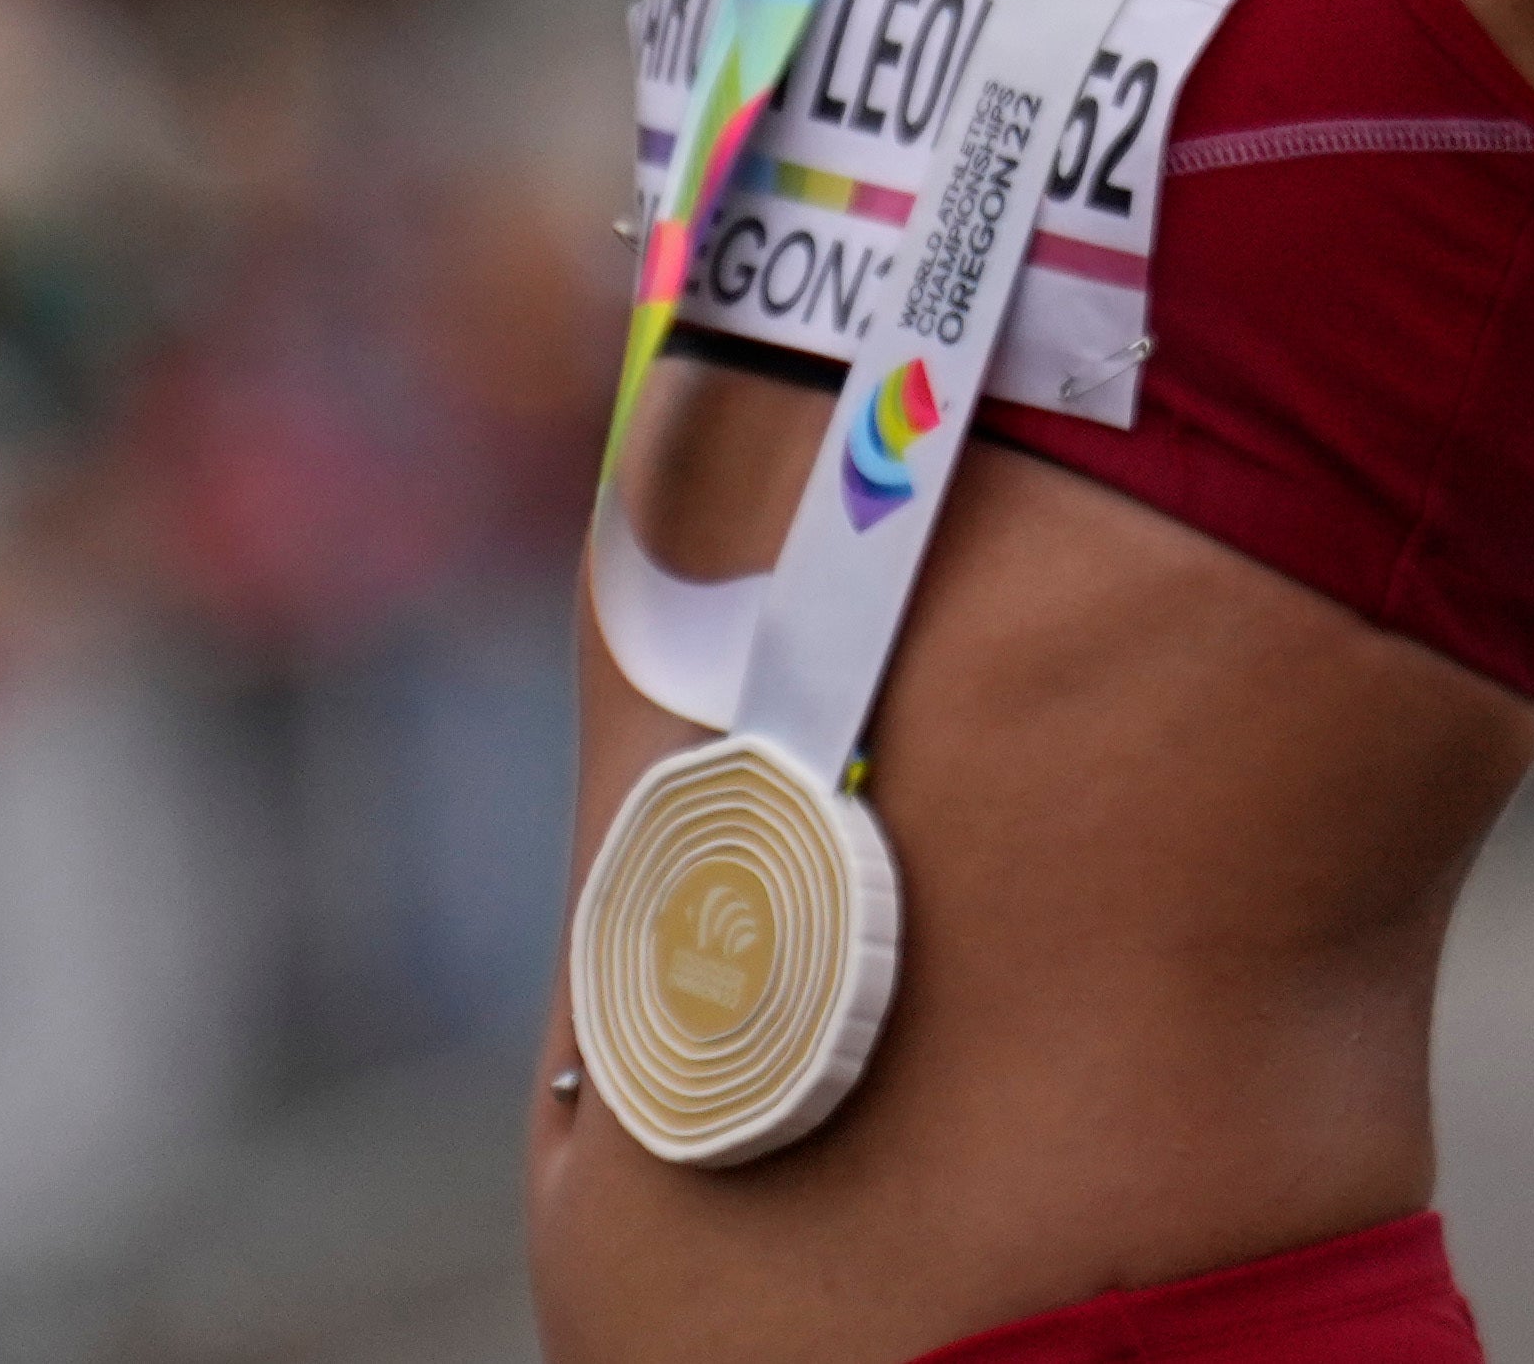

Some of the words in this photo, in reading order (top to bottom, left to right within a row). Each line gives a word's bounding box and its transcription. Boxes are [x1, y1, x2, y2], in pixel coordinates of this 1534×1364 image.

[899, 230, 943, 329] WORLD
[938, 79, 998, 225] ATHLETICS
[916, 85, 1014, 337] CHAMPIONSHIPS
